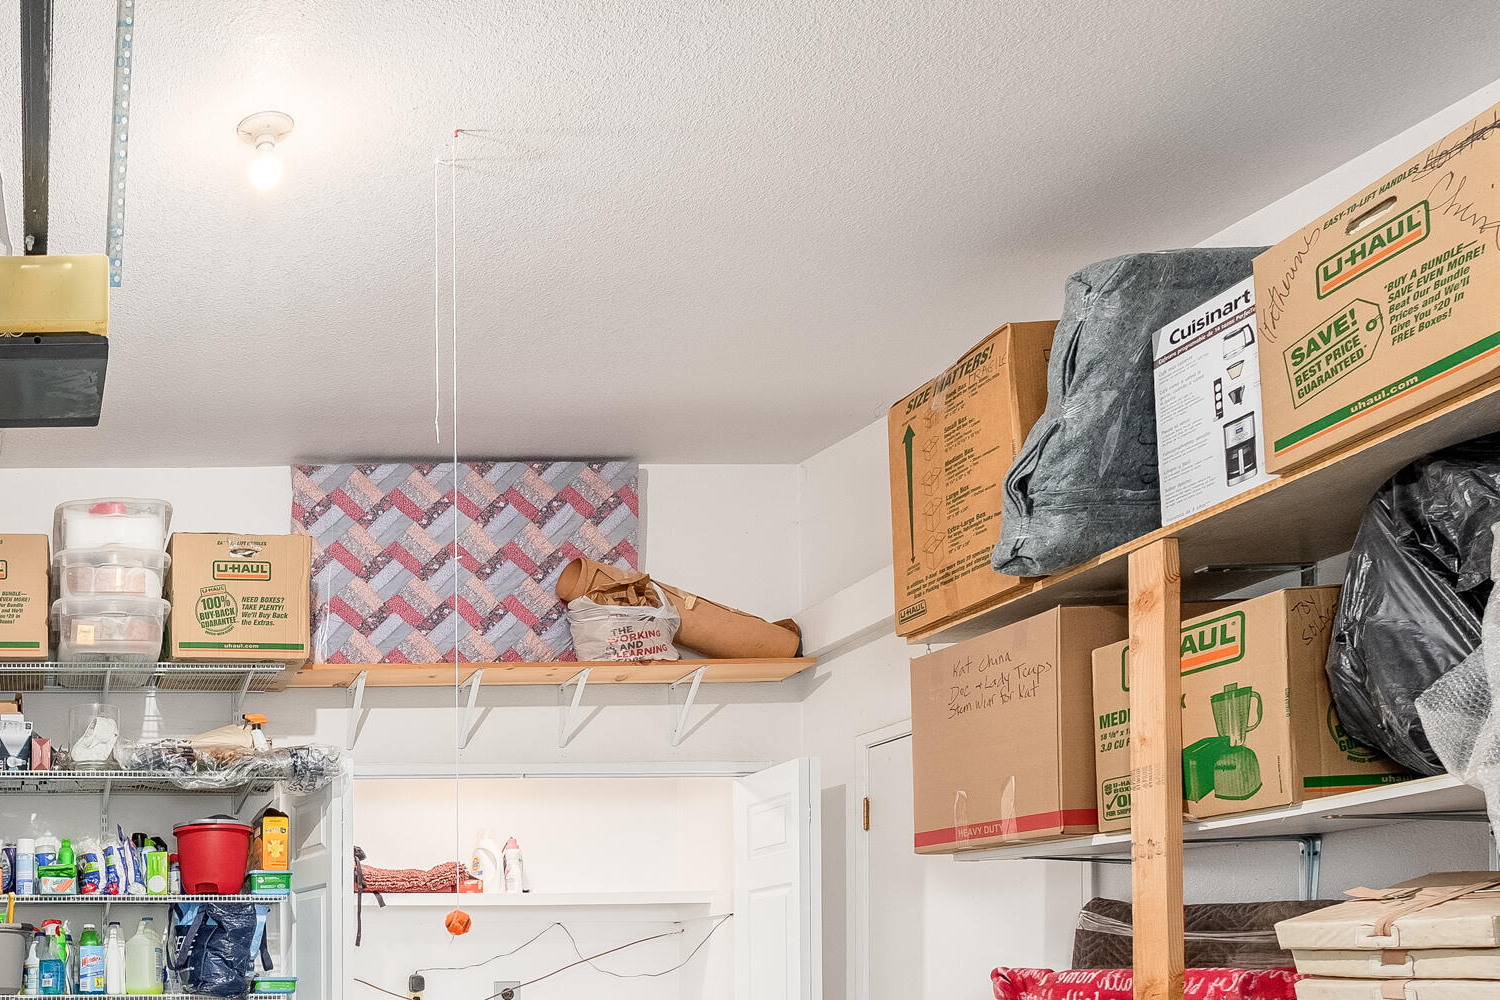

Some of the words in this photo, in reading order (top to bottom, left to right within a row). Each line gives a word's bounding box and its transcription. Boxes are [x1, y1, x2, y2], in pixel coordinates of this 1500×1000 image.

[1323, 191, 1378, 231] EASY-TO-LIFT
[1379, 163, 1420, 195] HANDLES
[1323, 214, 1422, 281] U-HAUL
[1387, 282, 1414, 303] SAVE
[1416, 266, 1444, 288] EVEN
[1447, 243, 1486, 272] MORE!
[1410, 269, 1417, 280] A
[1388, 298, 1410, 314] Beat
[1413, 286, 1431, 301] Our
[1434, 266, 1471, 290] Bundle
[1389, 305, 1419, 325] Prices
[1422, 291, 1441, 308] and
[1444, 276, 1470, 296] We'll
[1169, 289, 1251, 345] Cuisinart
[1390, 320, 1411, 336] Give
[1414, 308, 1431, 323] You
[1433, 297, 1451, 312] $20
[1454, 291, 1465, 302] in
[1391, 326, 1416, 346] FREE
[1418, 307, 1452, 333] Boxes!
[1291, 308, 1358, 367] SAVE!
[1294, 362, 1322, 388] BEST
[1326, 335, 1361, 366] PRICE
[906, 386, 932, 415] SIZE
[1350, 376, 1419, 413] uhaul.com
[946, 490, 959, 501] Large
[960, 485, 970, 494] Box
[947, 517, 975, 535] Extra-Large
[976, 512, 986, 520] Box
[216, 564, 268, 573] U-HAUL
[201, 595, 231, 611] 100%
[900, 603, 925, 619] U-HAUL
[199, 607, 235, 621] BUY-BACK
[201, 617, 236, 629] GUARANTEE
[611, 625, 634, 636] THE
[616, 644, 668, 658] LEARNING
[620, 640, 644, 651] AND
[953, 656, 973, 677] Kat
[1019, 680, 1039, 699] Kat
[1100, 742, 1112, 753] 3.0
[1113, 740, 1124, 750] CU
[958, 827, 982, 838] HEAVY
[984, 823, 1004, 834] DUTY
